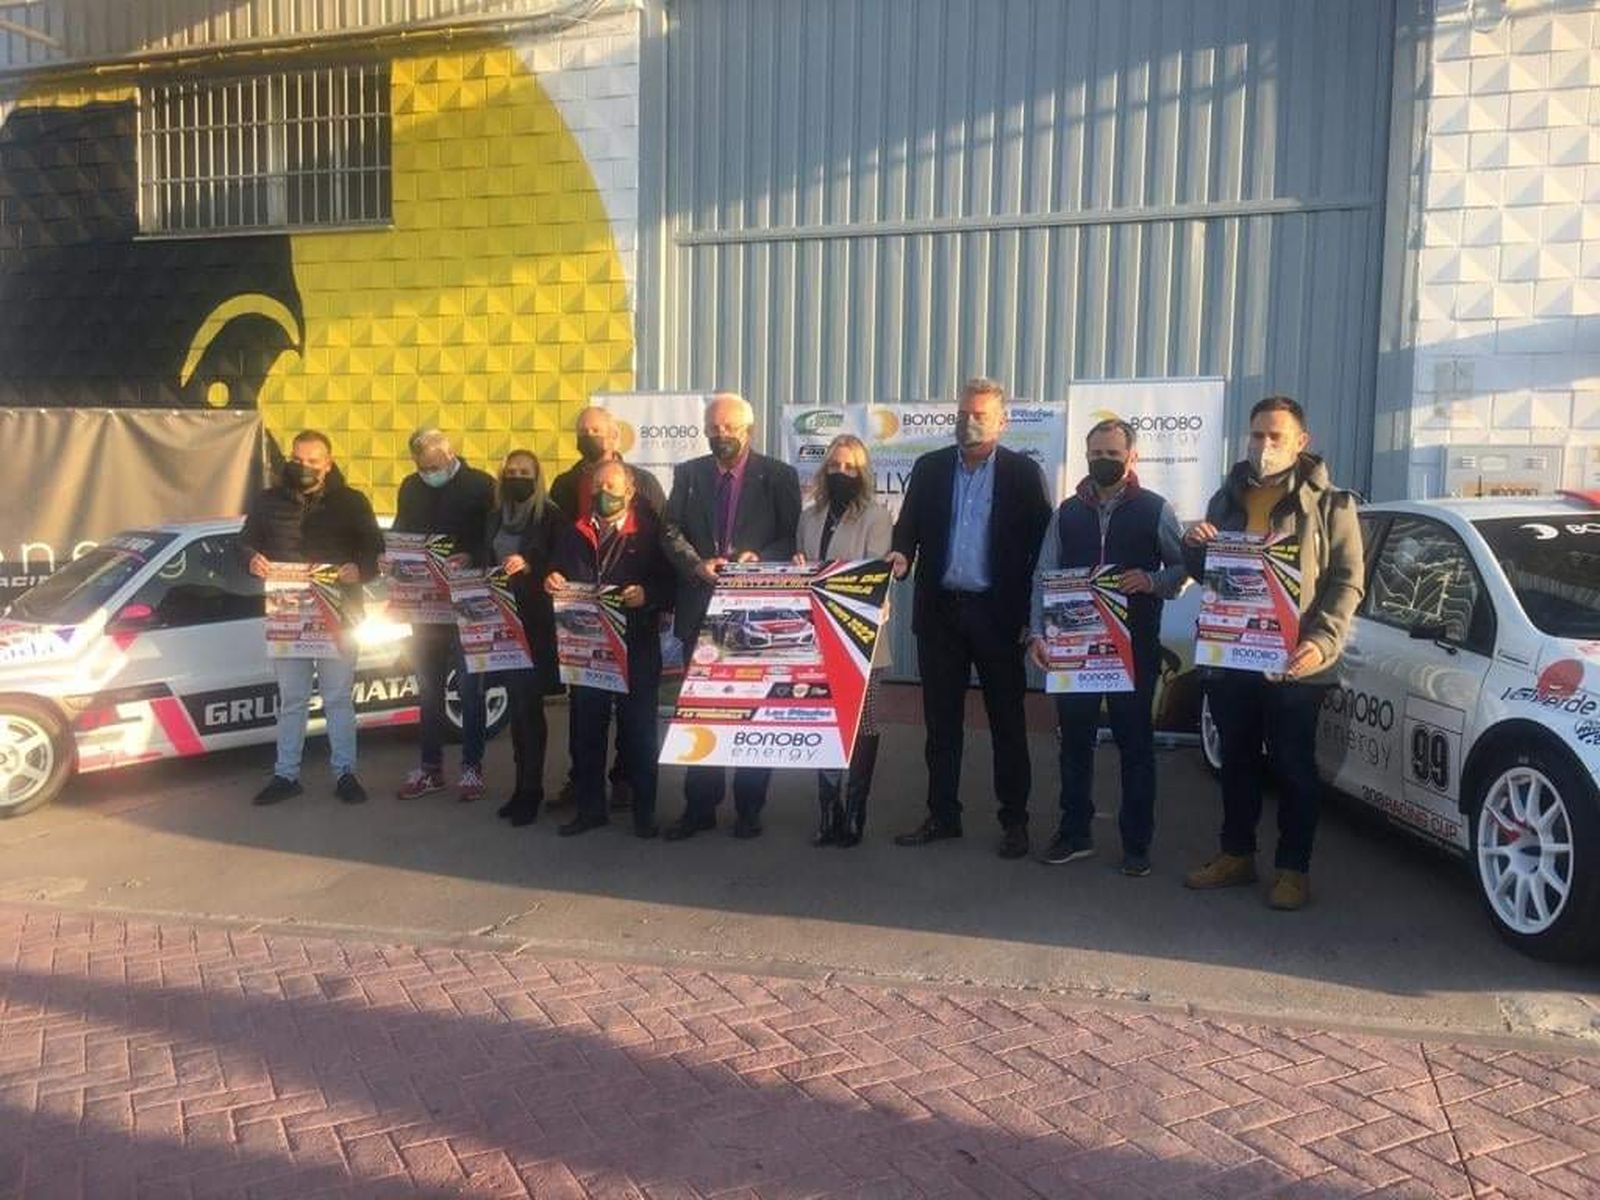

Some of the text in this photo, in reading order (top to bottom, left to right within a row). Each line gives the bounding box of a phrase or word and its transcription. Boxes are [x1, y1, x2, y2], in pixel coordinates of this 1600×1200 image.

[903, 413, 960, 426] BONOB
[1130, 416, 1202, 431] BONOBO
[733, 731, 823, 747] BONOBO
[732, 748, 818, 763] energy
[1413, 725, 1449, 791] 99
